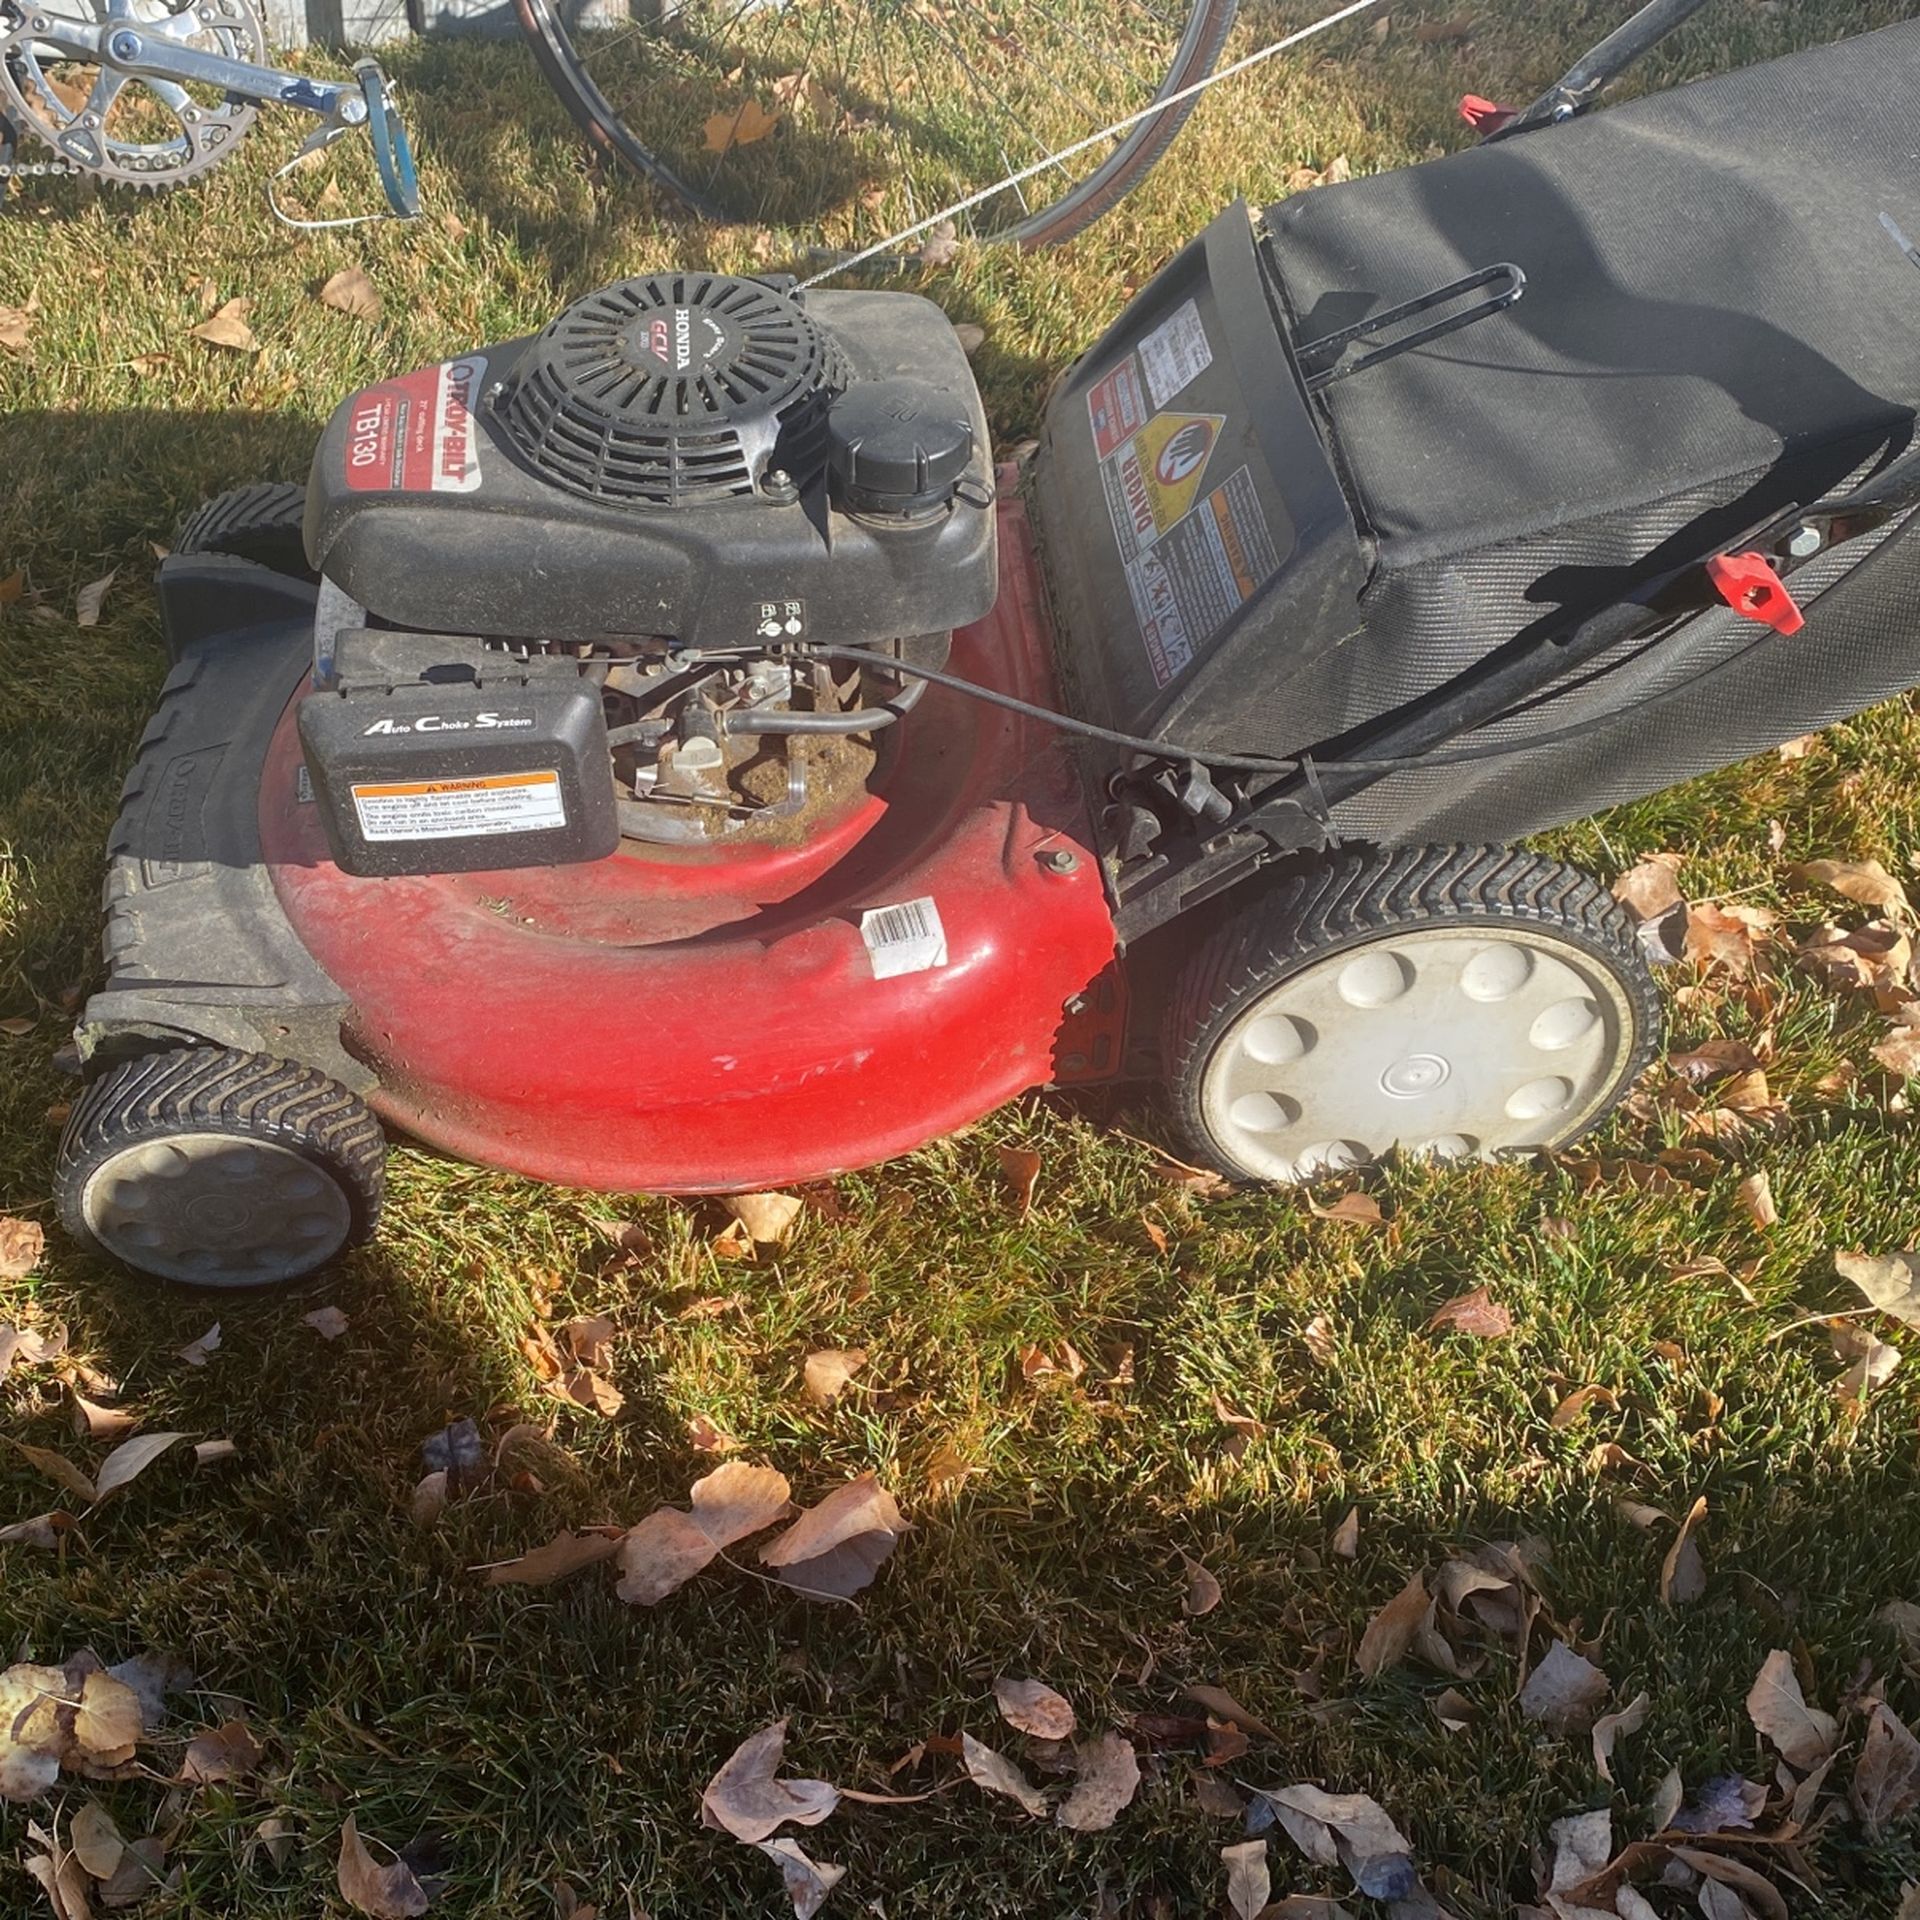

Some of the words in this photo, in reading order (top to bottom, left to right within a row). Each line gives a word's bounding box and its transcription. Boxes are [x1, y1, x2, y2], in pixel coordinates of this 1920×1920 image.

[650, 320, 668, 362] GCV
[676, 309, 690, 370] HONDA
[351, 402, 381, 467] TB130
[417, 411, 426, 435] cutting
[416, 435, 425, 453] deck
[1121, 454, 1154, 535] DANGER
[1220, 513, 1244, 566] WARNING
[1146, 623, 1166, 672] DANGER
[364, 719, 411, 736] Auto
[415, 716, 470, 732] Choke
[474, 712, 532, 729] System
[440, 781, 487, 792] WARNING
[381, 812, 407, 820] engine
[454, 807, 482, 815] carbon
[390, 825, 419, 833] Owner's
[421, 825, 448, 833] Manual
[449, 822, 474, 831] before
